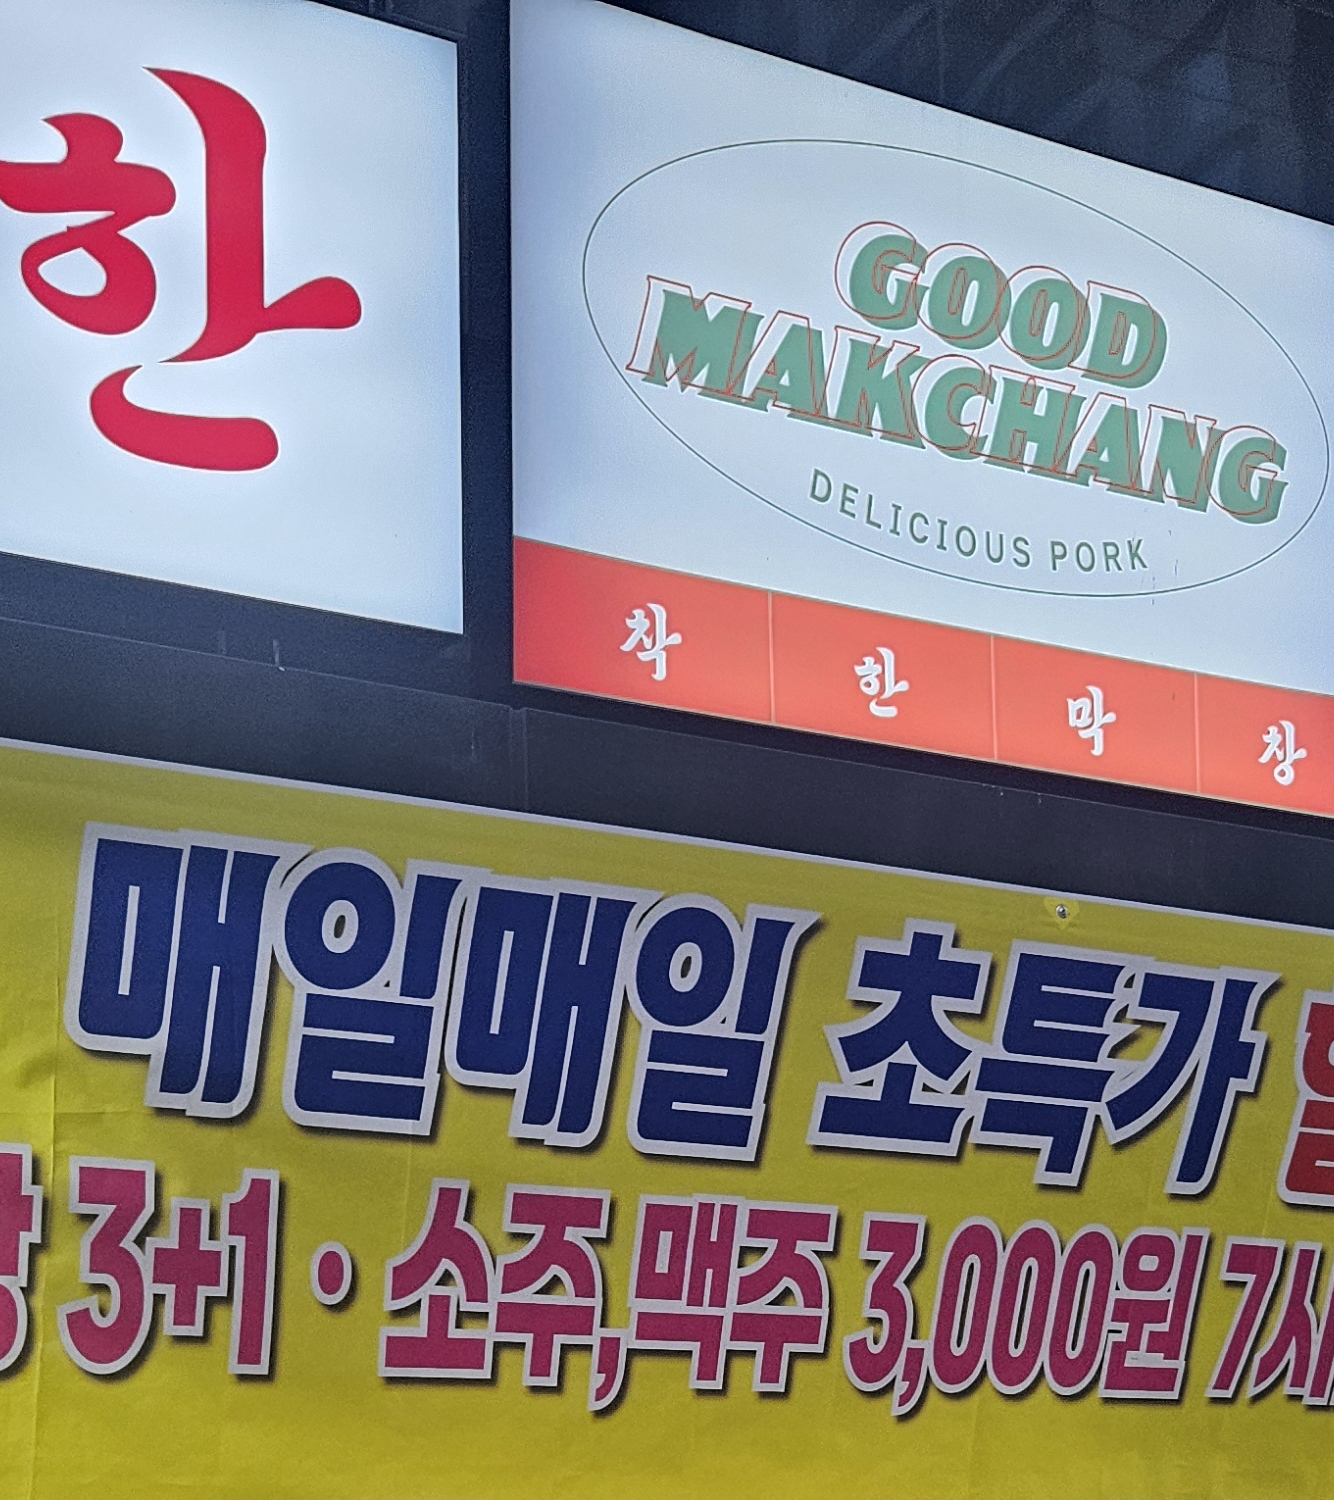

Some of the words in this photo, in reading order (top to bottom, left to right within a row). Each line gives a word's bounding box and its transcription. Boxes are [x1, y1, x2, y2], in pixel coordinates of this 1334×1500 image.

[624, 274, 1290, 526] MAKCHANG
[834, 220, 1168, 391] GOOD
[807, 466, 1033, 569] DELICIOUS
[1049, 536, 1150, 575] PORK
[71, 826, 812, 1155] 매일매일
[812, 925, 1275, 1190] 초특가
[61, 1155, 279, 1374] 3+1
[379, 1182, 837, 1412] 소주,맥주
[845, 1214, 1207, 1416] 3,000원
